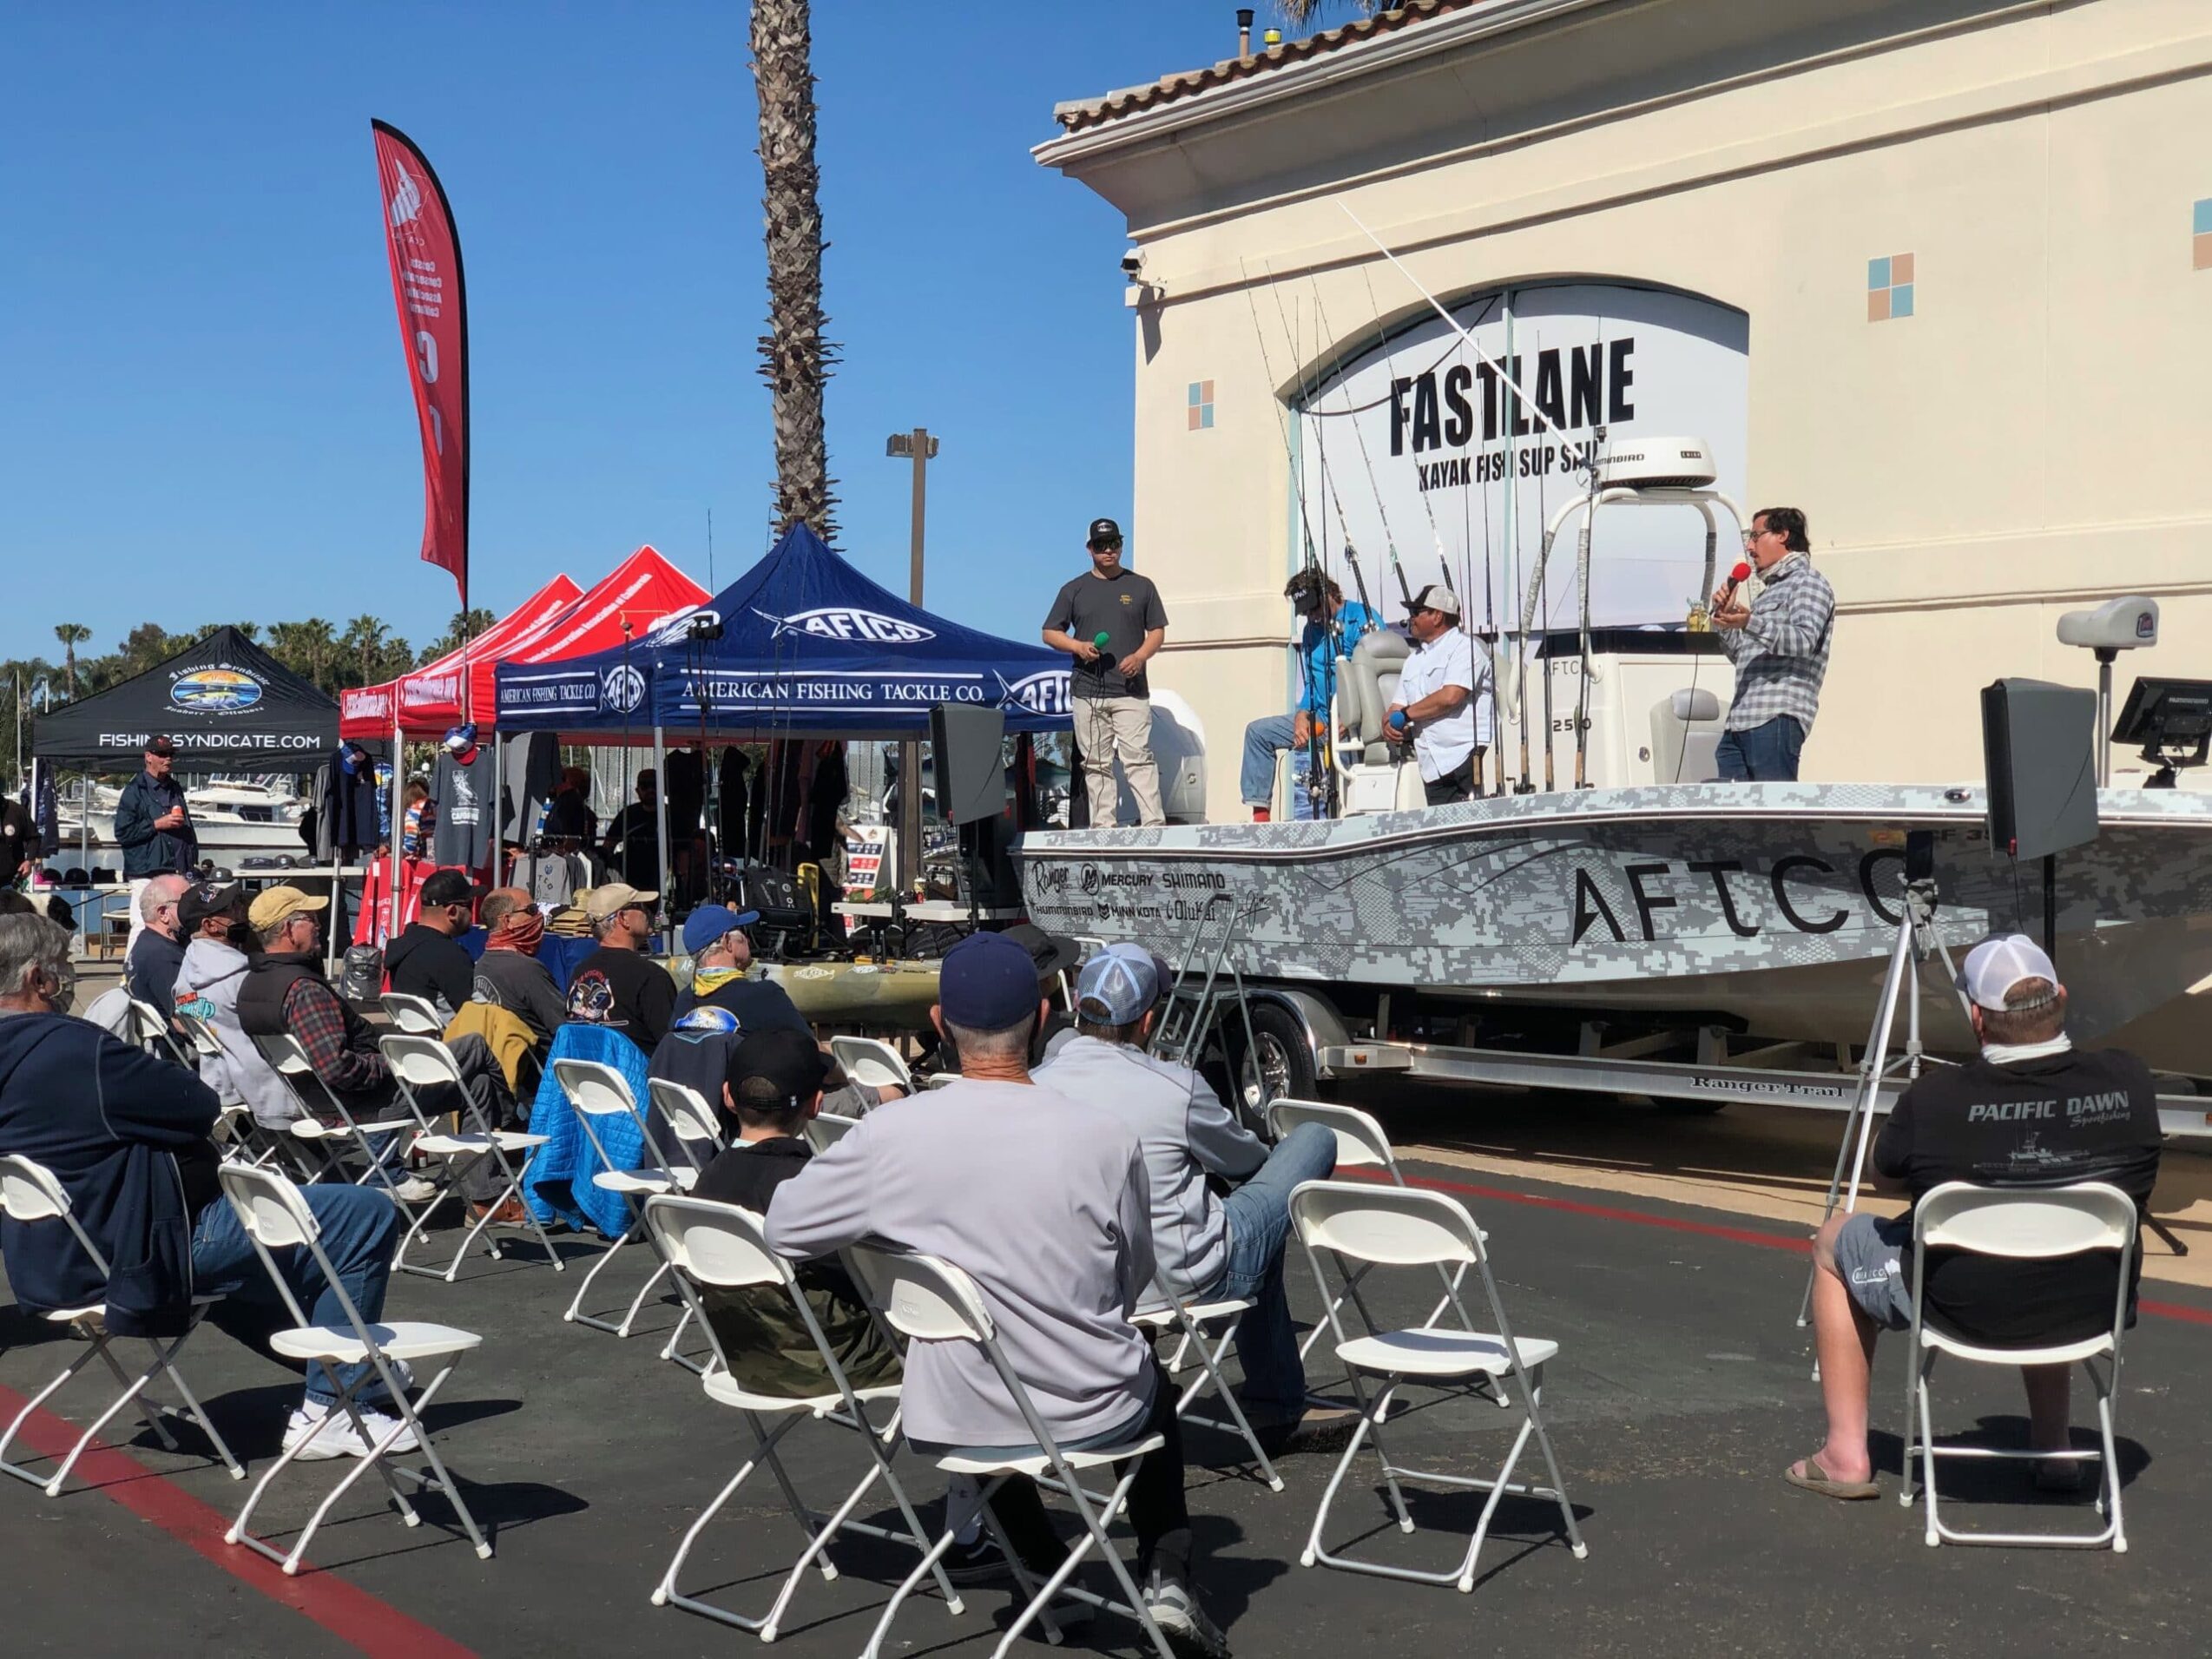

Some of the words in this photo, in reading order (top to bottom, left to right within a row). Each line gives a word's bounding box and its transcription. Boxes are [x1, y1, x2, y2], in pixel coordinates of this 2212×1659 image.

[1391, 337, 1635, 457] FASTLANE
[1419, 456, 1471, 492] KAYAK
[1477, 450, 1513, 483] FISH
[1519, 446, 1555, 477] SUP
[805, 607, 923, 641] AFTCO
[499, 687, 531, 703] AMERICAN
[532, 685, 557, 702] FISHING
[560, 683, 583, 701] TACKLE
[681, 681, 789, 700] AMERICAN
[797, 683, 872, 701] FISHING
[880, 682, 951, 701] TACKLE
[956, 682, 986, 702] CO.
[1019, 670, 1074, 713] AFT
[99, 733, 320, 748] FISHISYNDICATE.COM
[1031, 860, 1070, 898] Ranger
[1101, 873, 1154, 886] MERCURY
[1162, 872, 1226, 889] SHIMANO
[1036, 905, 1094, 917] HUMMINBIRD
[1111, 905, 1136, 918] MINN
[1137, 907, 1162, 918] KOTA
[1967, 1100, 2057, 1122] PACIFIC
[2066, 1090, 2130, 1116] DAWN
[2070, 1110, 2131, 1128] Sportfishing
